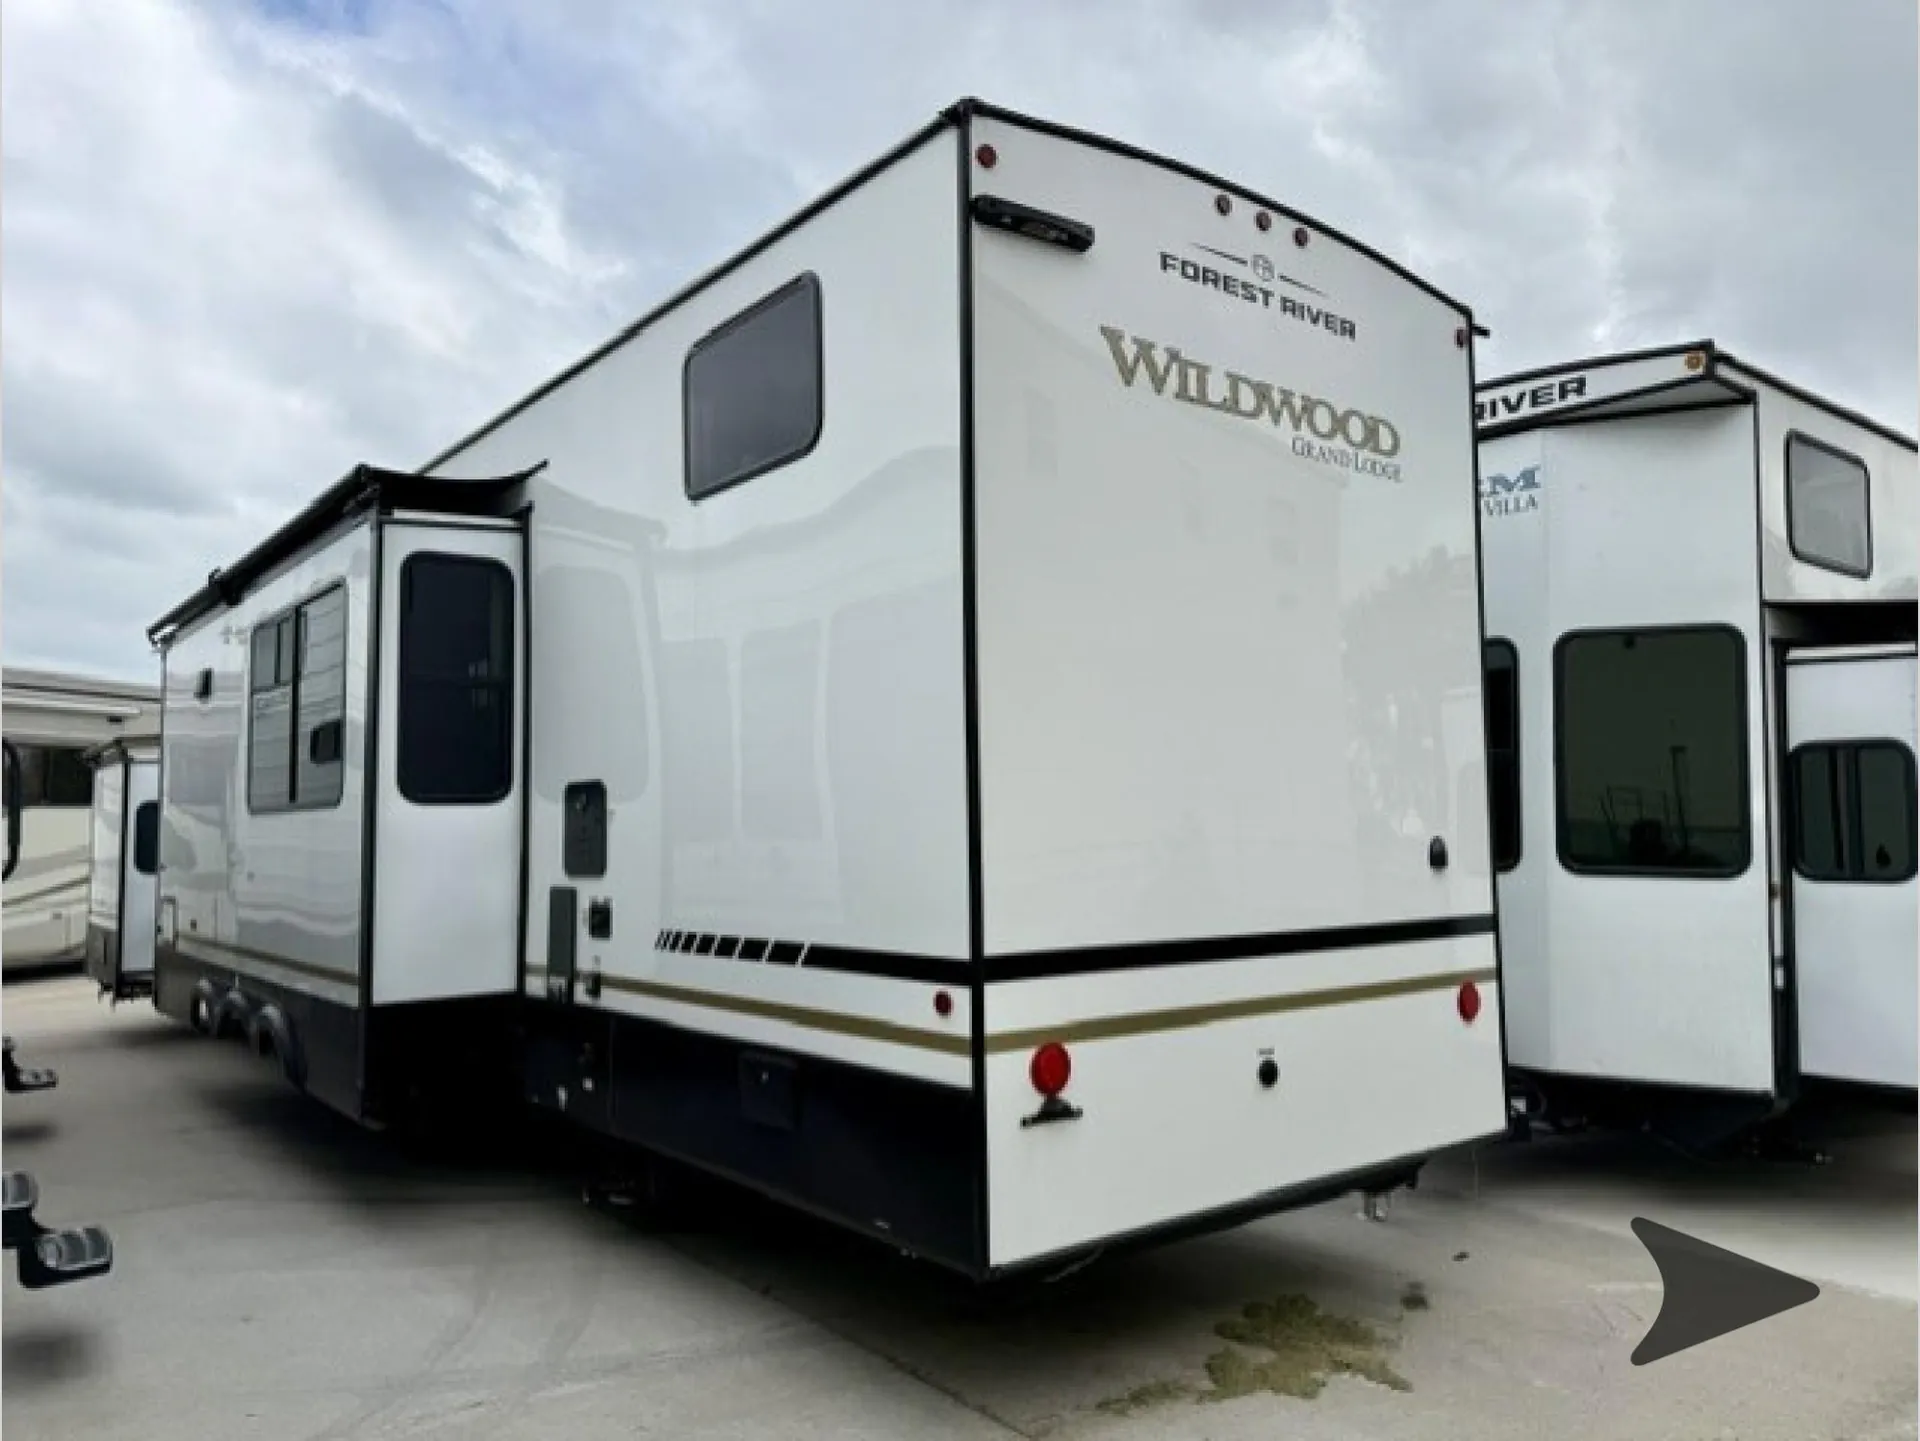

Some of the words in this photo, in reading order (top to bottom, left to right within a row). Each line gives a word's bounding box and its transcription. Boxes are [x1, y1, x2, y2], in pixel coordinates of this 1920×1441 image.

[1159, 251, 1275, 308] FOREST
[1279, 296, 1356, 342] RIVER
[1099, 325, 1401, 457] WILDWOOD
